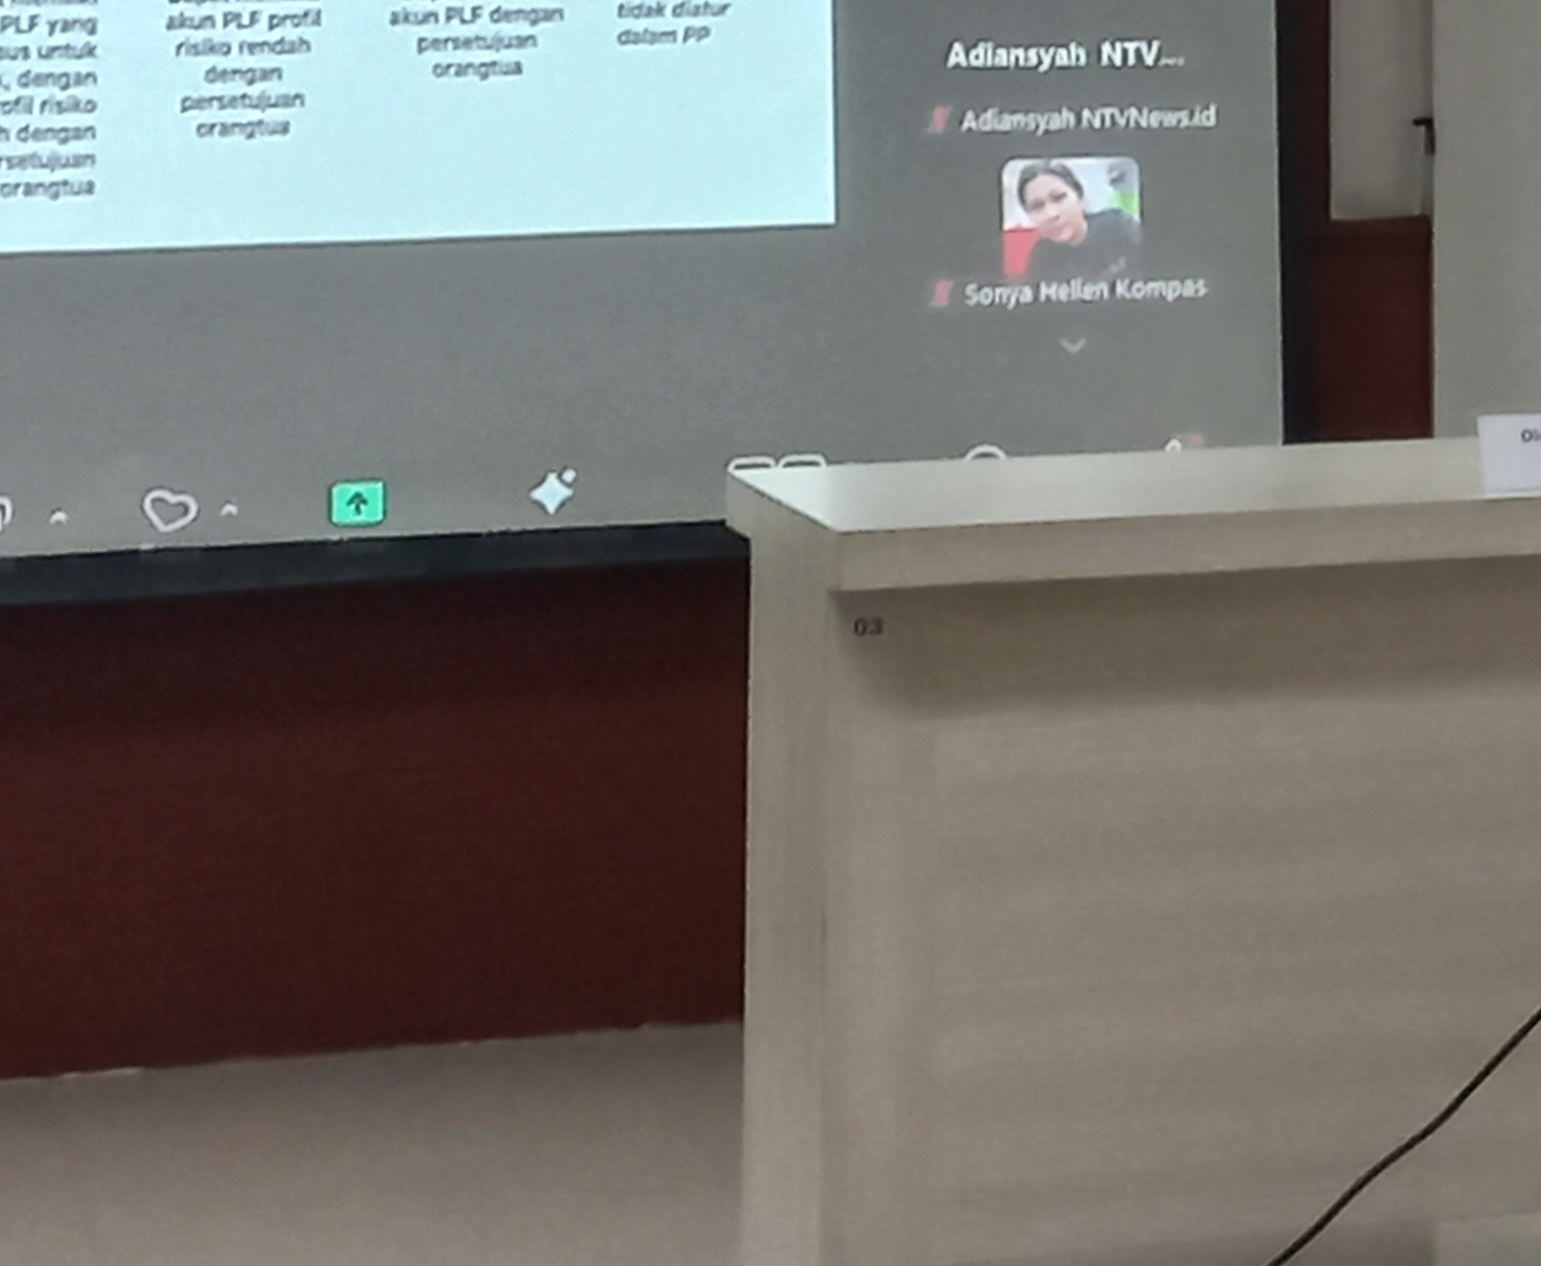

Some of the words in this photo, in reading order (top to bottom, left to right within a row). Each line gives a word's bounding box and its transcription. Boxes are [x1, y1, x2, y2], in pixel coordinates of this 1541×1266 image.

[165, 12, 216, 31] akun
[222, 10, 260, 30] PLF
[268, 9, 322, 31] profil
[389, 9, 439, 27] akun
[445, 6, 483, 25] PLF
[489, 5, 565, 27] dengan
[617, 1, 665, 19] tidak
[671, 0, 731, 18] diatur
[1, 15, 40, 34] PLF
[46, 17, 98, 37] yang
[175, 40, 232, 57] risiko
[239, 37, 311, 55] rendah
[417, 33, 538, 55] persetujuan
[617, 28, 677, 46] dalam
[37, 43, 98, 60] untuk
[947, 42, 1087, 72] Adiansyah
[16, 69, 98, 91] dengan
[204, 65, 283, 86] dengan
[432, 60, 523, 81] orangtua
[40, 98, 98, 114] risiko
[180, 92, 305, 114] persetujuan
[196, 119, 290, 139] orangtua
[961, 110, 1074, 135] Adiansyah
[1081, 104, 1218, 130] NTVNews.id
[15, 126, 96, 144] dengan
[1, 178, 95, 200] orangtua
[964, 283, 1033, 310] Sonya
[1039, 281, 1108, 303] Hellen
[1115, 278, 1207, 302] Kompas
[854, 618, 883, 637] 03
